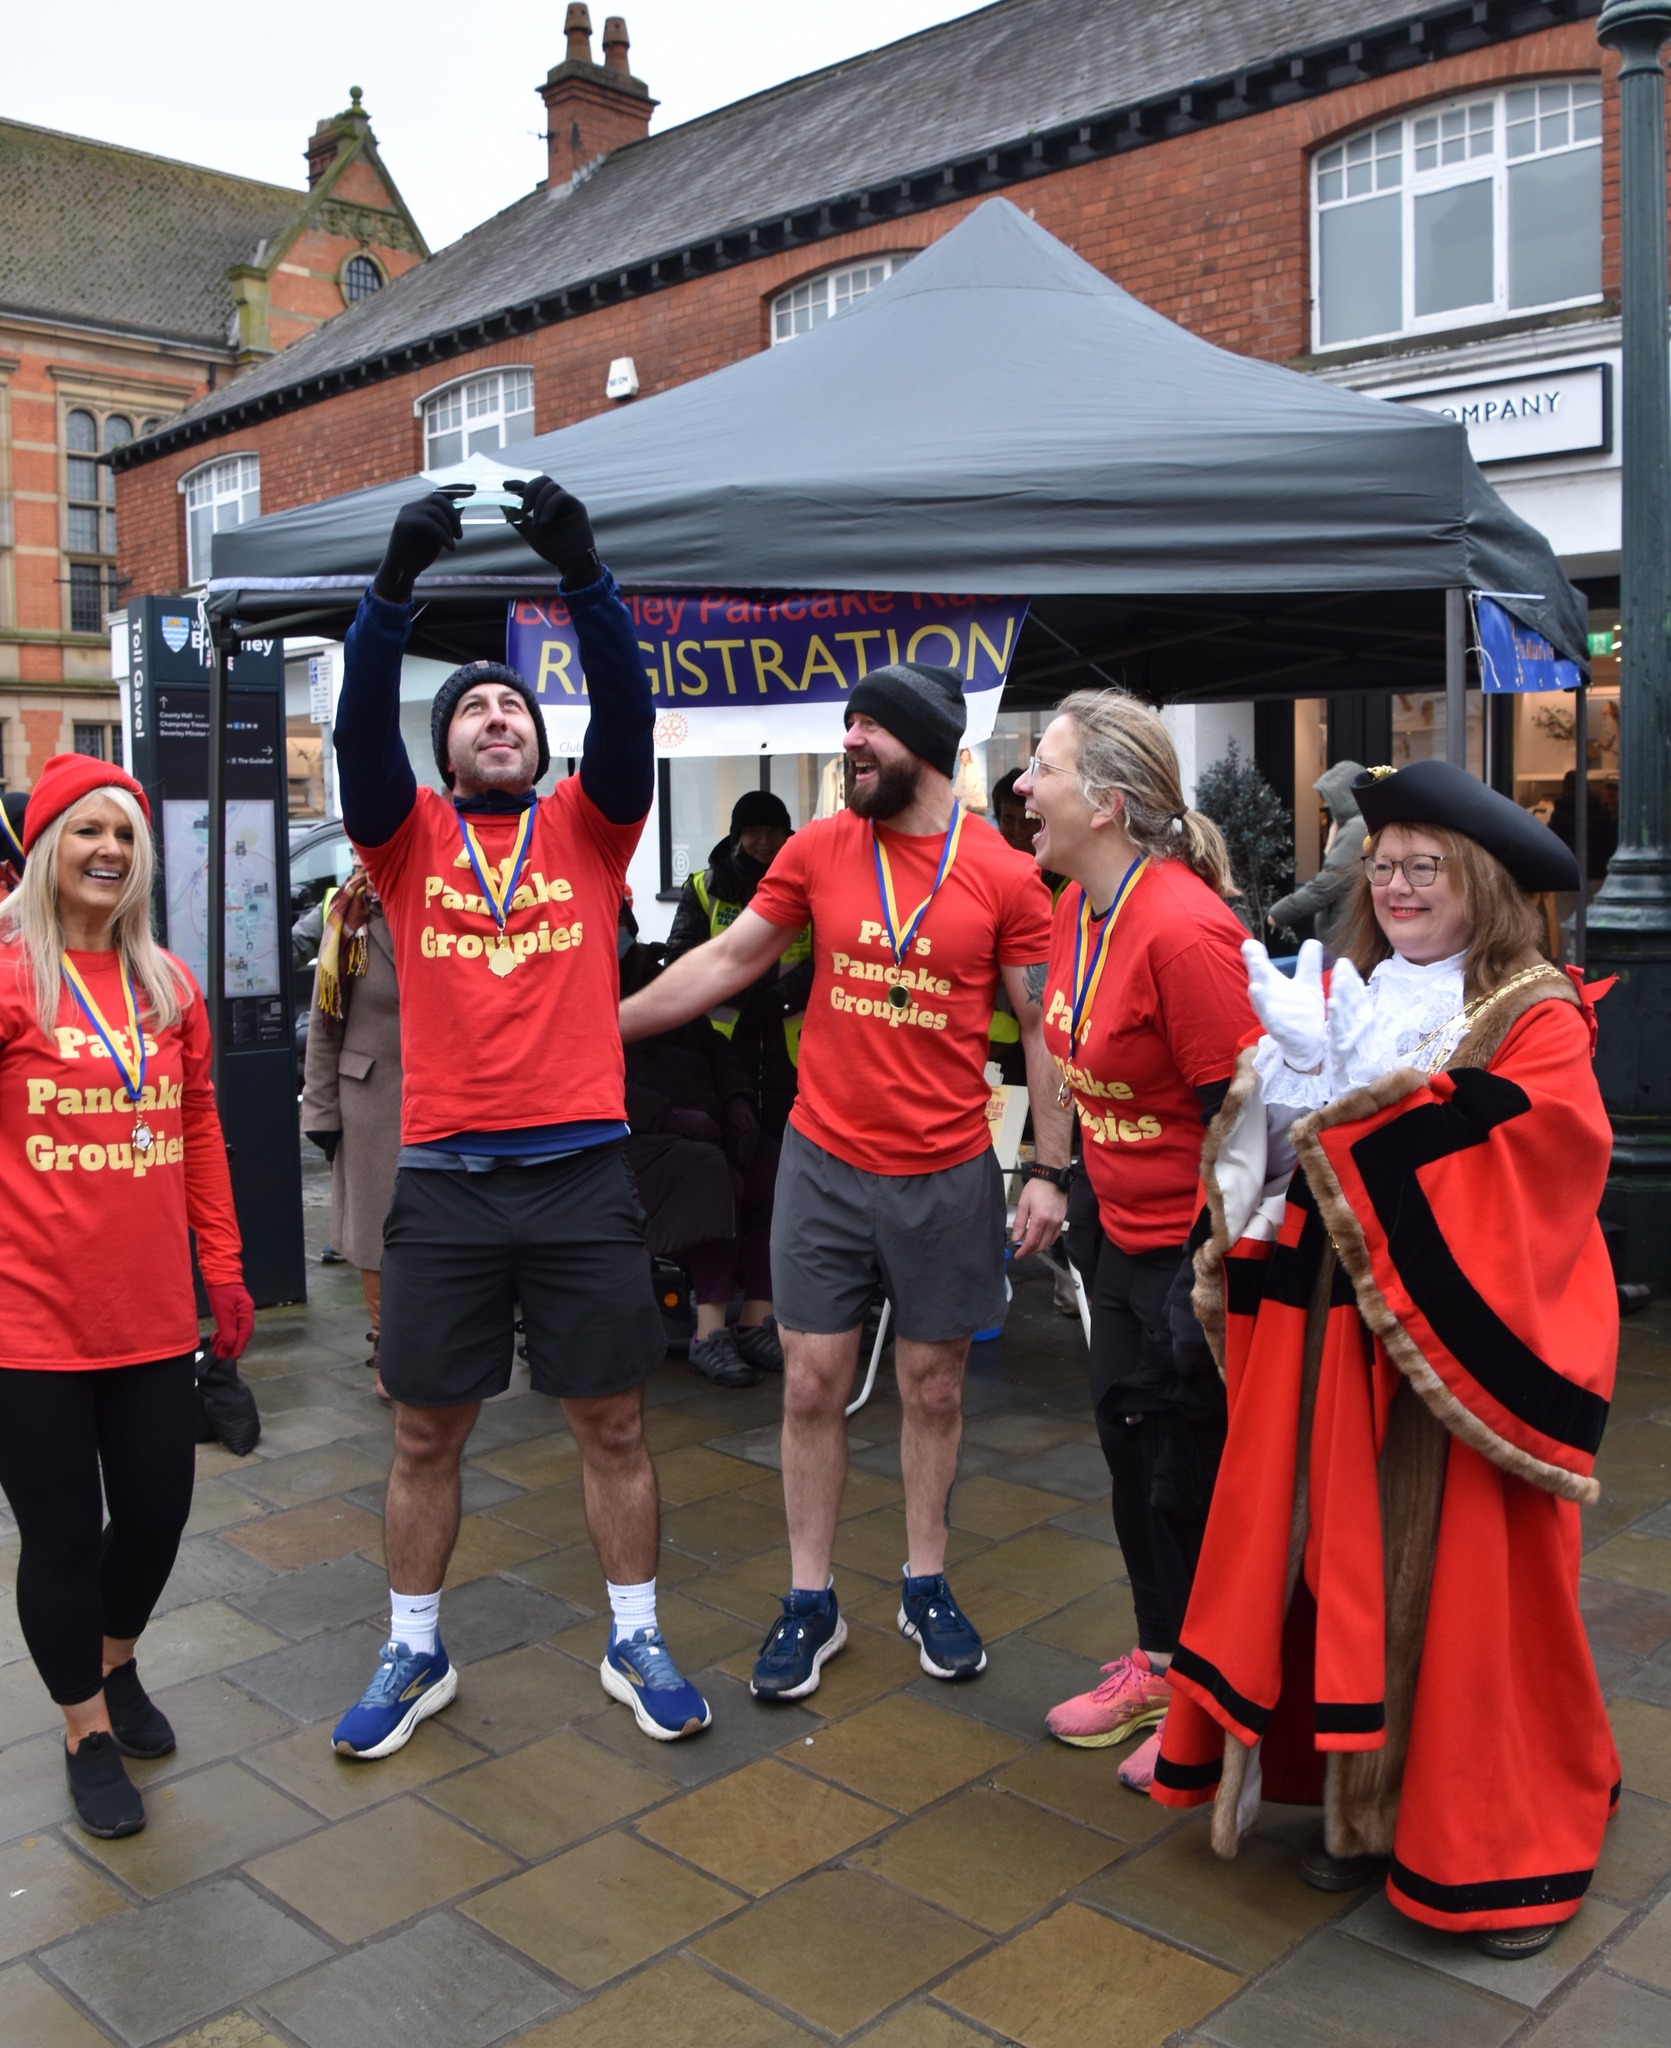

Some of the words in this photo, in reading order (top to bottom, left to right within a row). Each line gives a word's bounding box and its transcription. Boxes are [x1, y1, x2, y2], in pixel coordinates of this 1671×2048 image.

[1440, 391, 1560, 425] OMPANY
[132, 617, 143, 663] Toll
[133, 669, 145, 738] Gavel
[159, 712, 180, 720] County
[159, 730, 184, 738] Beverley
[248, 757, 274, 765] Guildhall
[420, 921, 583, 964] Groupies
[857, 919, 932, 956] Pa's
[832, 952, 952, 996] Pancake
[830, 986, 948, 1031] Groupies
